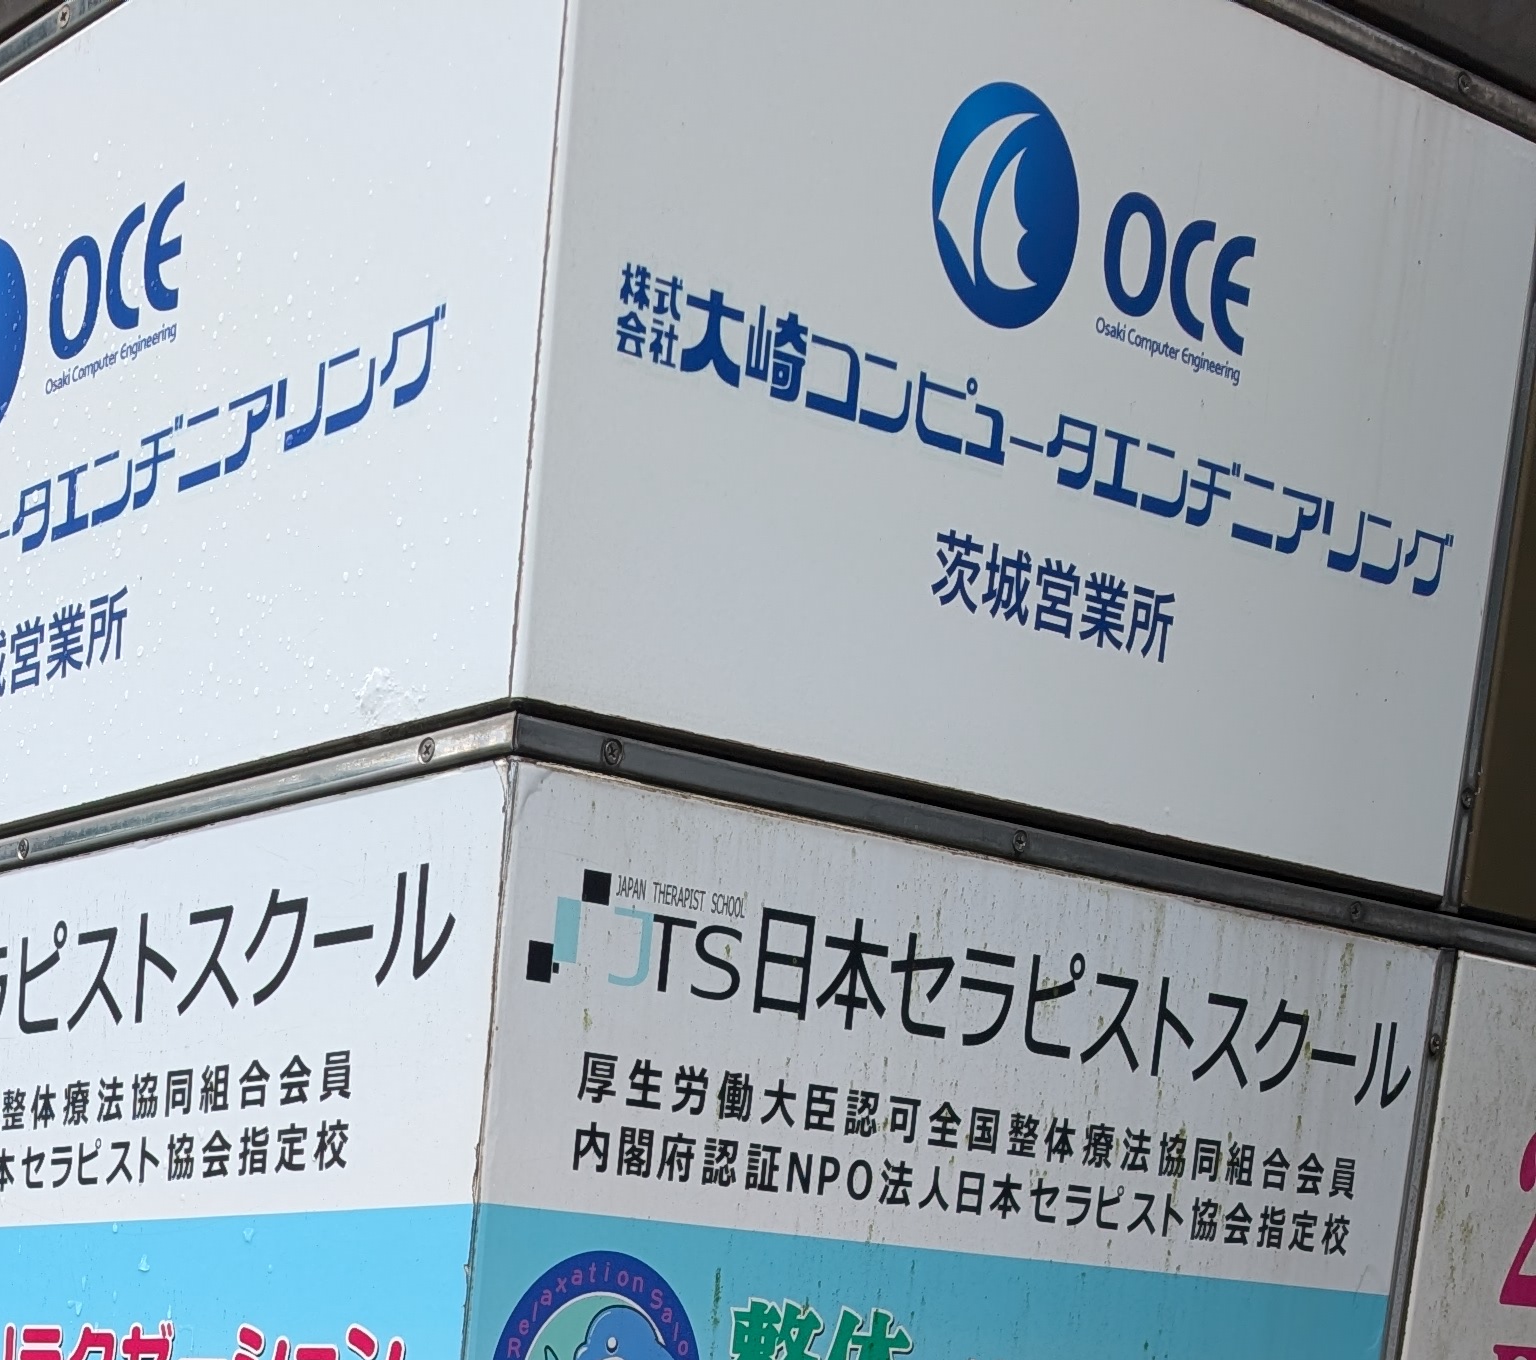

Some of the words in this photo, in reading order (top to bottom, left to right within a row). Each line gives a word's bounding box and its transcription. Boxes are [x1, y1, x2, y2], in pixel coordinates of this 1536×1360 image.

[49, 180, 186, 359] OCE
[1103, 191, 1257, 357] OCE
[45, 368, 71, 395] Osaki
[72, 350, 118, 383] Computer
[120, 323, 177, 362] Engineering
[1096, 317, 1126, 342] Osaki
[1128, 329, 1180, 360] Computer
[1182, 348, 1240, 386] Engineering
[931, 529, 1177, 663] 茨城営業所
[616, 875, 646, 900] JAPAN
[653, 882, 706, 911] THERAPIST
[711, 893, 745, 918] SCHOOL
[577, 1052, 1356, 1201] 厚生労働大臣認可全国整体療法協同組合会員
[507, 1262, 645, 1359] Relaxation
